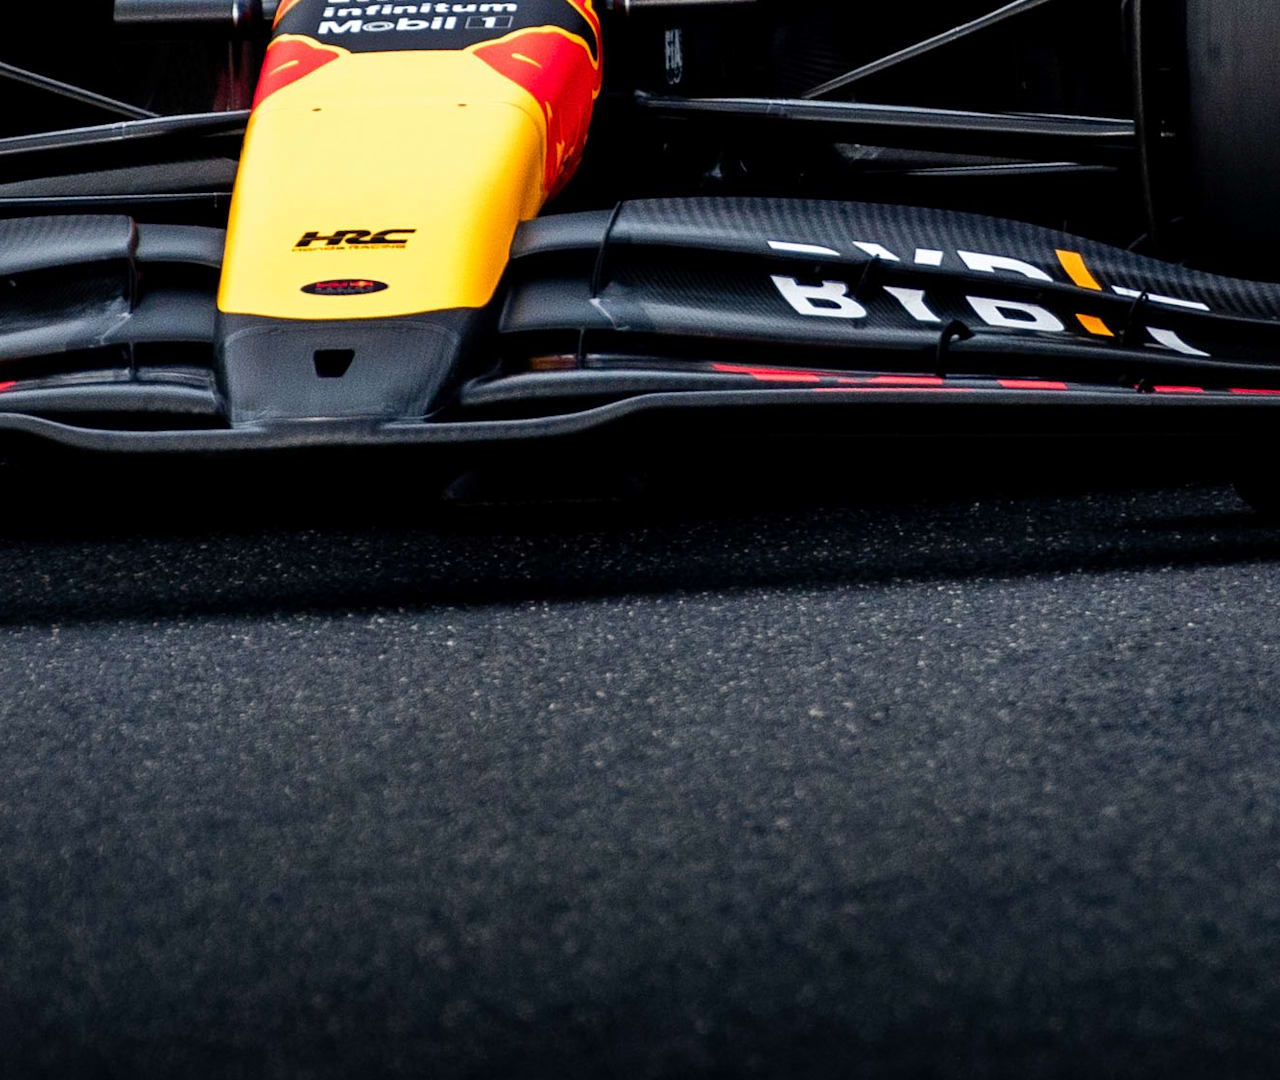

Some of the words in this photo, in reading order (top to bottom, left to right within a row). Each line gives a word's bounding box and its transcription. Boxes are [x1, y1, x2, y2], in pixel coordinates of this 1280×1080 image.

[322, 2, 519, 18] infinitum
[317, 16, 458, 35] Mobil
[295, 228, 417, 248] HRC
